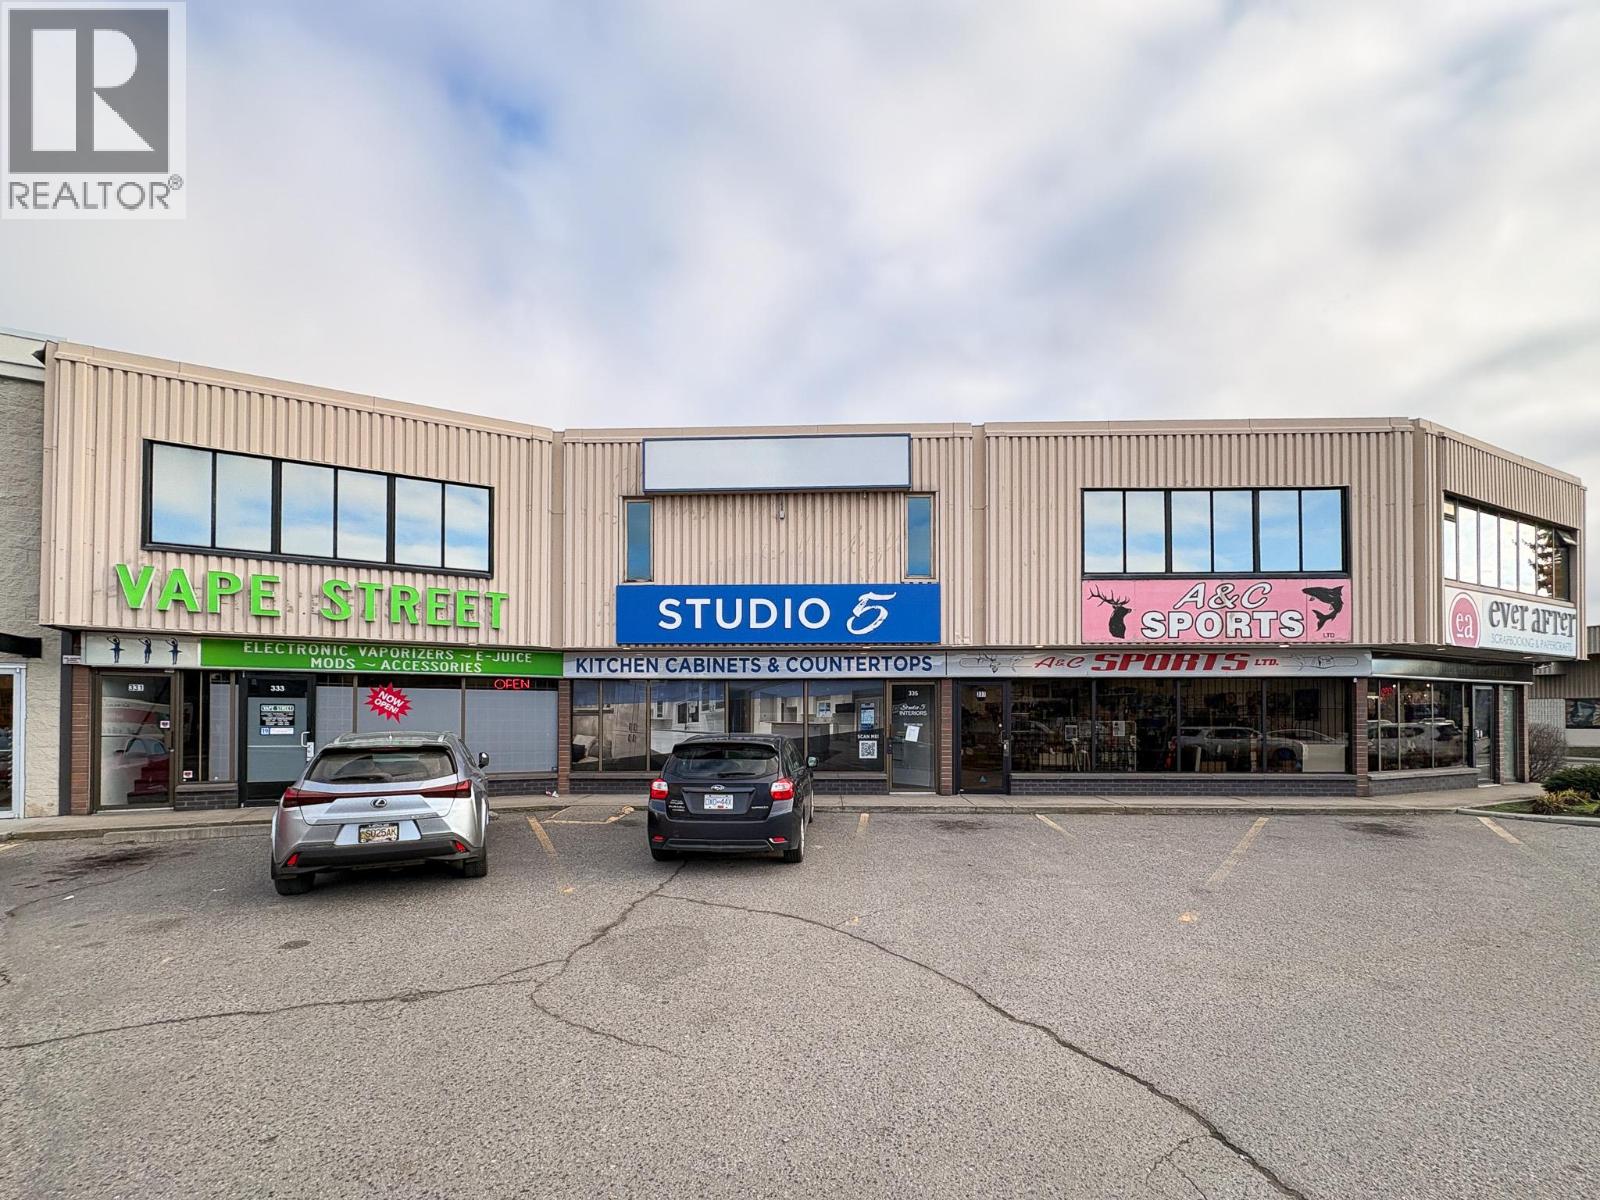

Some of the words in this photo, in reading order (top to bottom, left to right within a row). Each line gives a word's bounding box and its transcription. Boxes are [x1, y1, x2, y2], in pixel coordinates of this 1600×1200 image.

[115, 564, 282, 617] VAPE
[320, 579, 509, 629] STREET
[1173, 582, 1273, 610] A&C
[658, 597, 831, 630] STUDIO
[846, 591, 897, 635] 5
[1141, 610, 1305, 639] SPORTS
[1488, 600, 1529, 632] ever
[1455, 613, 1475, 639] ea
[243, 641, 349, 657] ELECTRONIC
[358, 646, 454, 660] VAPORIZERS
[476, 651, 532, 663] E-JUICE
[576, 657, 659, 673] KITCHEN
[665, 657, 761, 673] CABINETS
[767, 657, 780, 673] &
[786, 655, 933, 673] COUNTERTOPS
[1034, 656, 1085, 669] A&C
[1091, 653, 1250, 672] SPORTS
[310, 658, 356, 669] MODS
[381, 660, 482, 673] ACCESSORIES
[494, 679, 530, 689] OPEN
[378, 691, 405, 707] NOW
